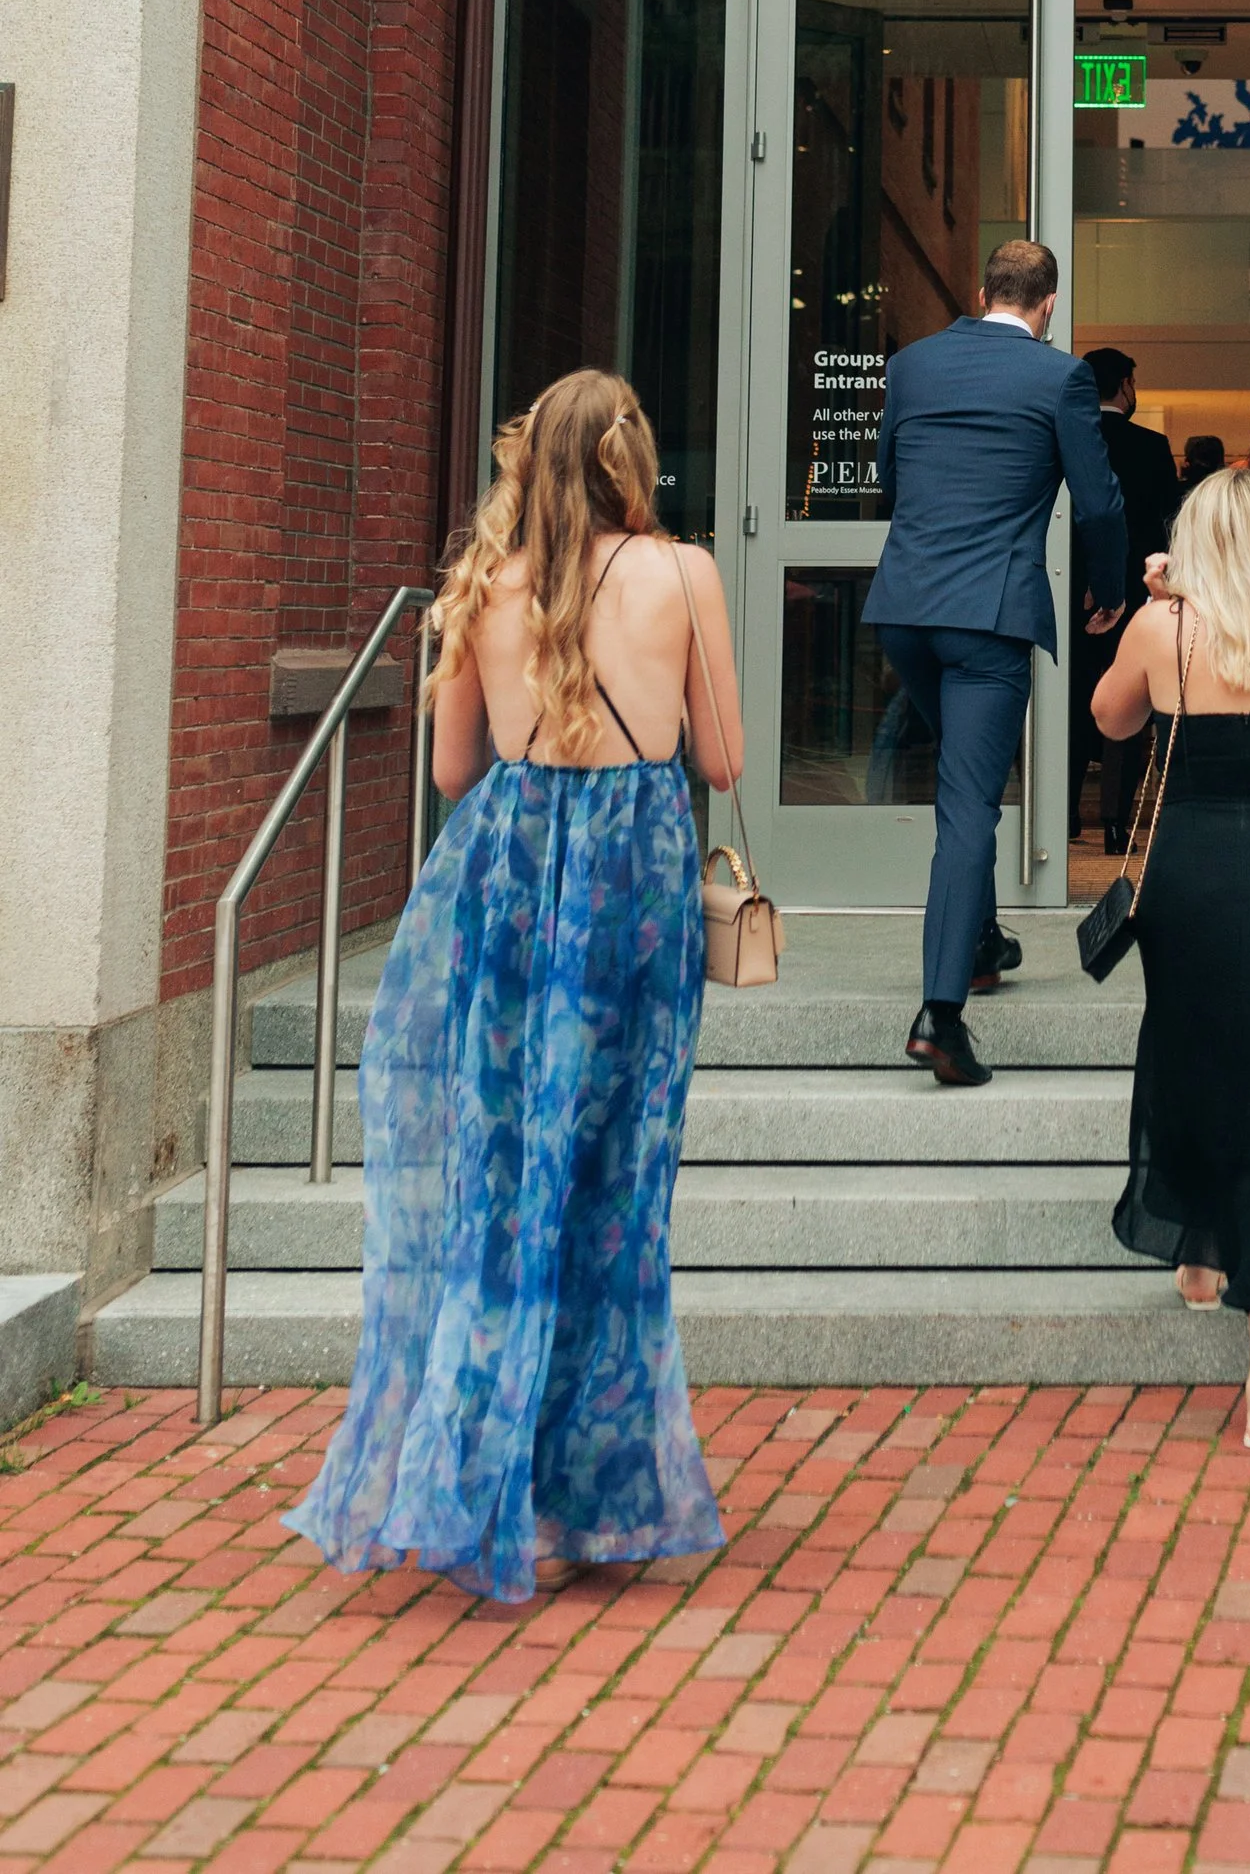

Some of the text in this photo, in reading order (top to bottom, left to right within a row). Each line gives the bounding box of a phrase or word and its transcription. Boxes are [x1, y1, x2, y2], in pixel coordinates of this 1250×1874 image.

[814, 350, 885, 371] Groups
[814, 373, 887, 389] Entranc
[812, 408, 884, 421] All other vi
[812, 430, 836, 440] use
[839, 427, 861, 440] the
[811, 486, 883, 495] Peabody Essex Museu
